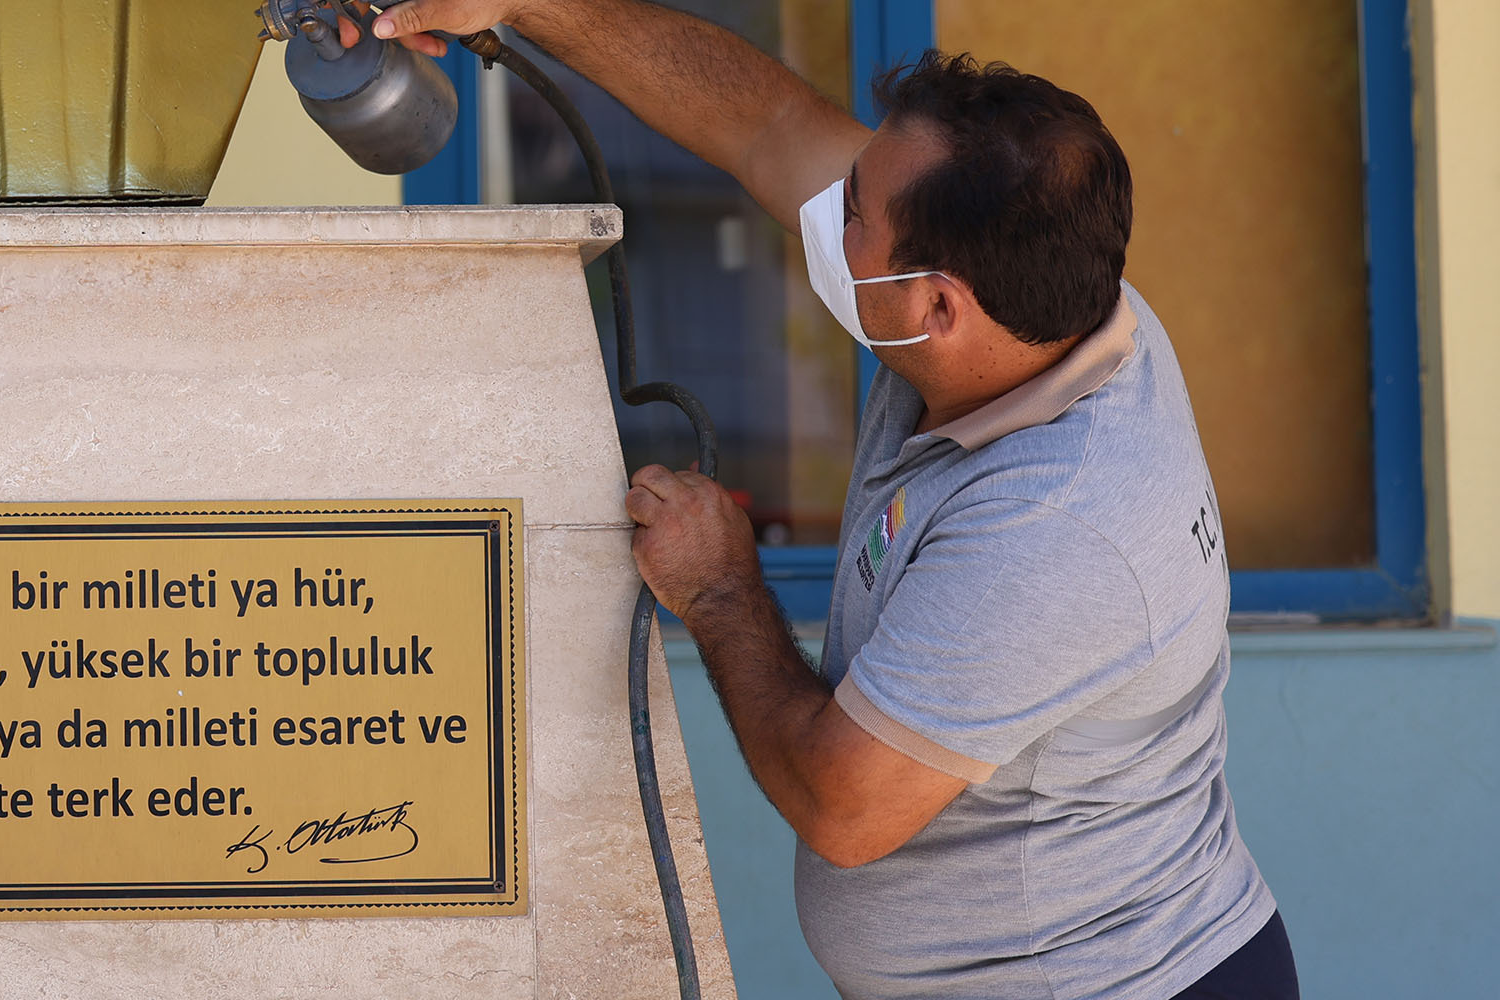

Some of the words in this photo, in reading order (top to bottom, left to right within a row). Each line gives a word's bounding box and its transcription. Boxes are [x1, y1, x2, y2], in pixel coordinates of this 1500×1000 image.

[11, 570, 69, 610] bir
[83, 568, 217, 609] milleti
[230, 578, 278, 618] ya
[294, 567, 374, 613] hür,
[21, 638, 171, 689] yüksek
[185, 637, 242, 678] bir
[253, 634, 434, 686] topluluk
[57, 708, 107, 749] da
[124, 706, 257, 748] milleti
[272, 709, 406, 746] esaret
[418, 714, 467, 744] ve
[46, 777, 135, 818] terk
[147, 776, 253, 817] eder.
